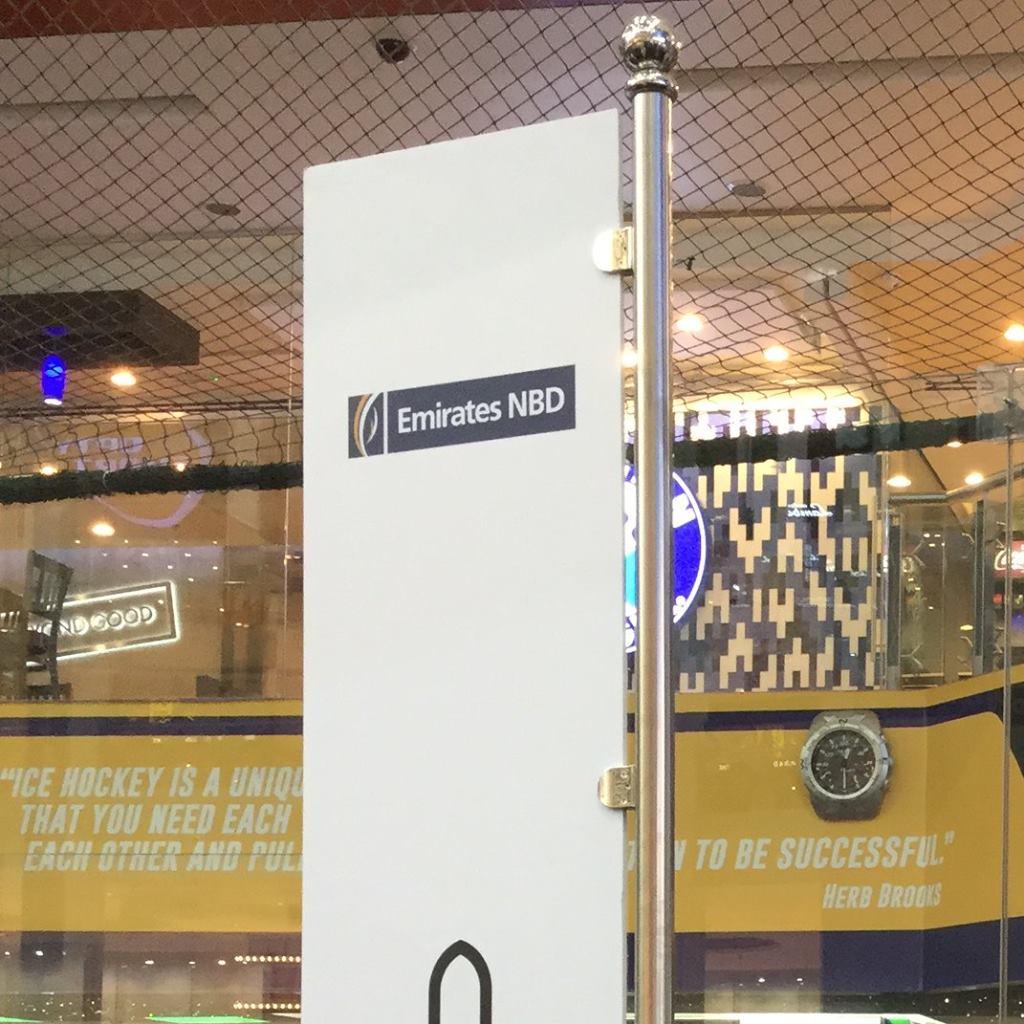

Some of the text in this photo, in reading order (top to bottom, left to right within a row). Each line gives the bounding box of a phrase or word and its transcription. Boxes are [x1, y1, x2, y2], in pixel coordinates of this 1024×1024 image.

[398, 386, 565, 434] Emirates NBD
[60, 767, 165, 797] HOCKEY
[169, 767, 197, 797] IS
[203, 767, 222, 797] A
[20, 804, 292, 834] THAT YOU NEED EACH
[24, 841, 303, 871] EACH OTHER AND PUL
[696, 838, 728, 870] TO
[734, 838, 771, 870] BE
